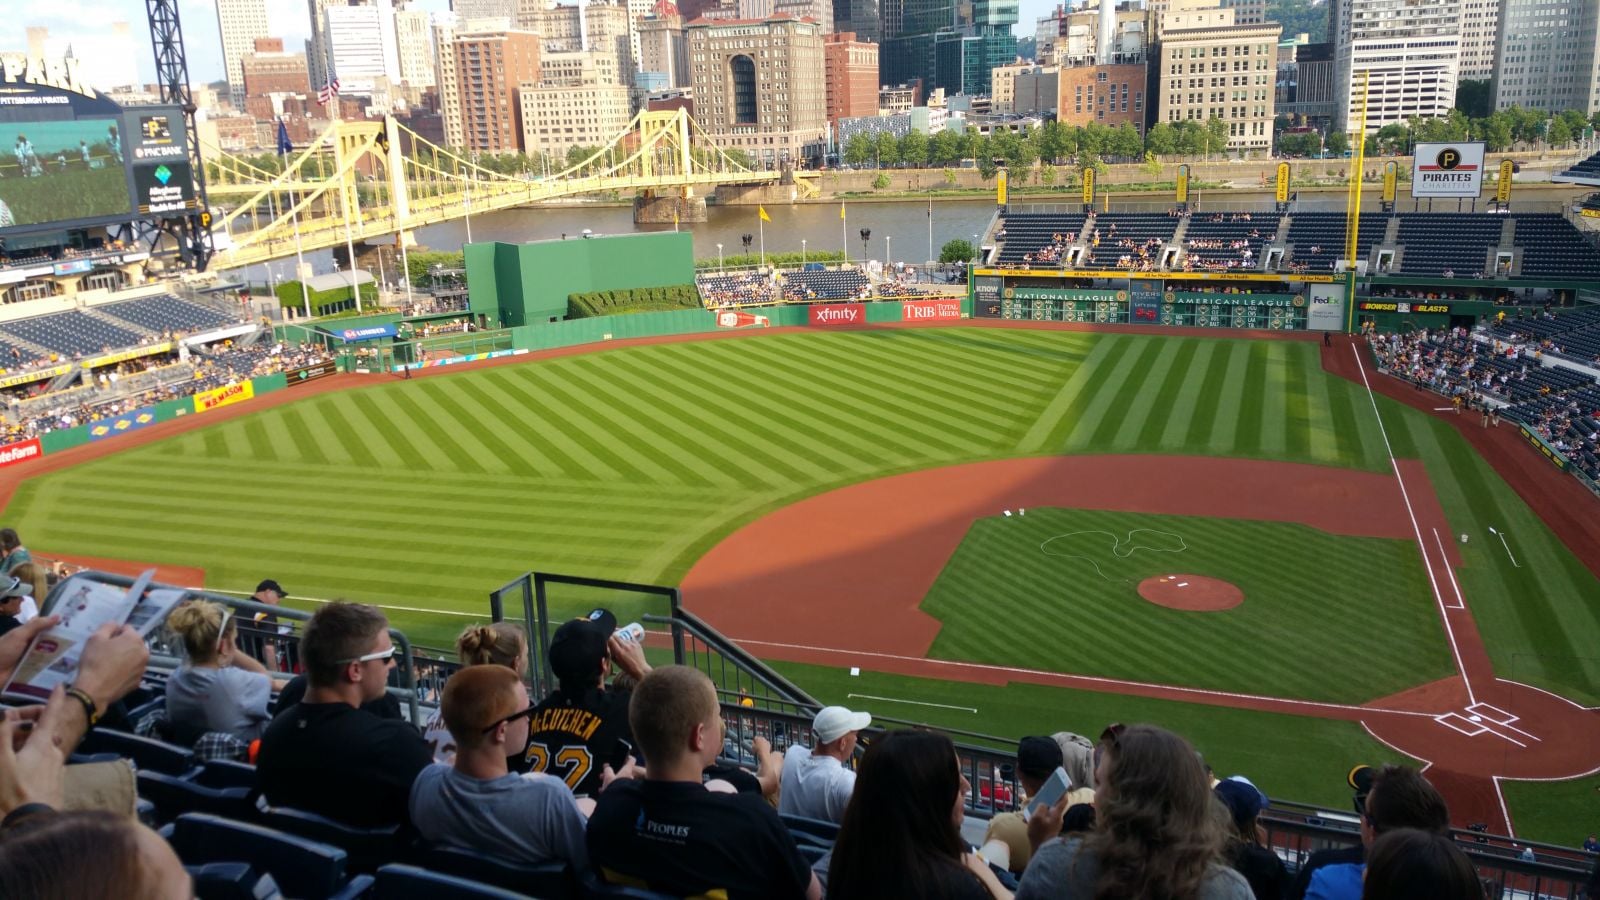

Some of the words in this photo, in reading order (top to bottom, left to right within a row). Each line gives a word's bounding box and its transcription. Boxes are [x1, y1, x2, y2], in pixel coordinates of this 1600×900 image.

[42, 95, 69, 104] PIRATES
[144, 148, 162, 157] PNC
[162, 146, 183, 155] BANK
[1423, 173, 1471, 181] PIRATES
[1502, 164, 1510, 182] Health
[1313, 296, 1340, 304] FedEx
[904, 305, 934, 318] TRIB
[936, 303, 959, 311] TOTAL
[1366, 303, 1397, 311] BOWSER
[816, 307, 857, 322] xfinity
[357, 328, 386, 336] LUMBER
[10, 373, 31, 385] CITY
[33, 368, 57, 381] BEER
[218, 385, 245, 402] MASON
[531, 709, 602, 741] McCUTCHEN
[525, 743, 593, 793] 22
[647, 820, 689, 837] PEOPLES
